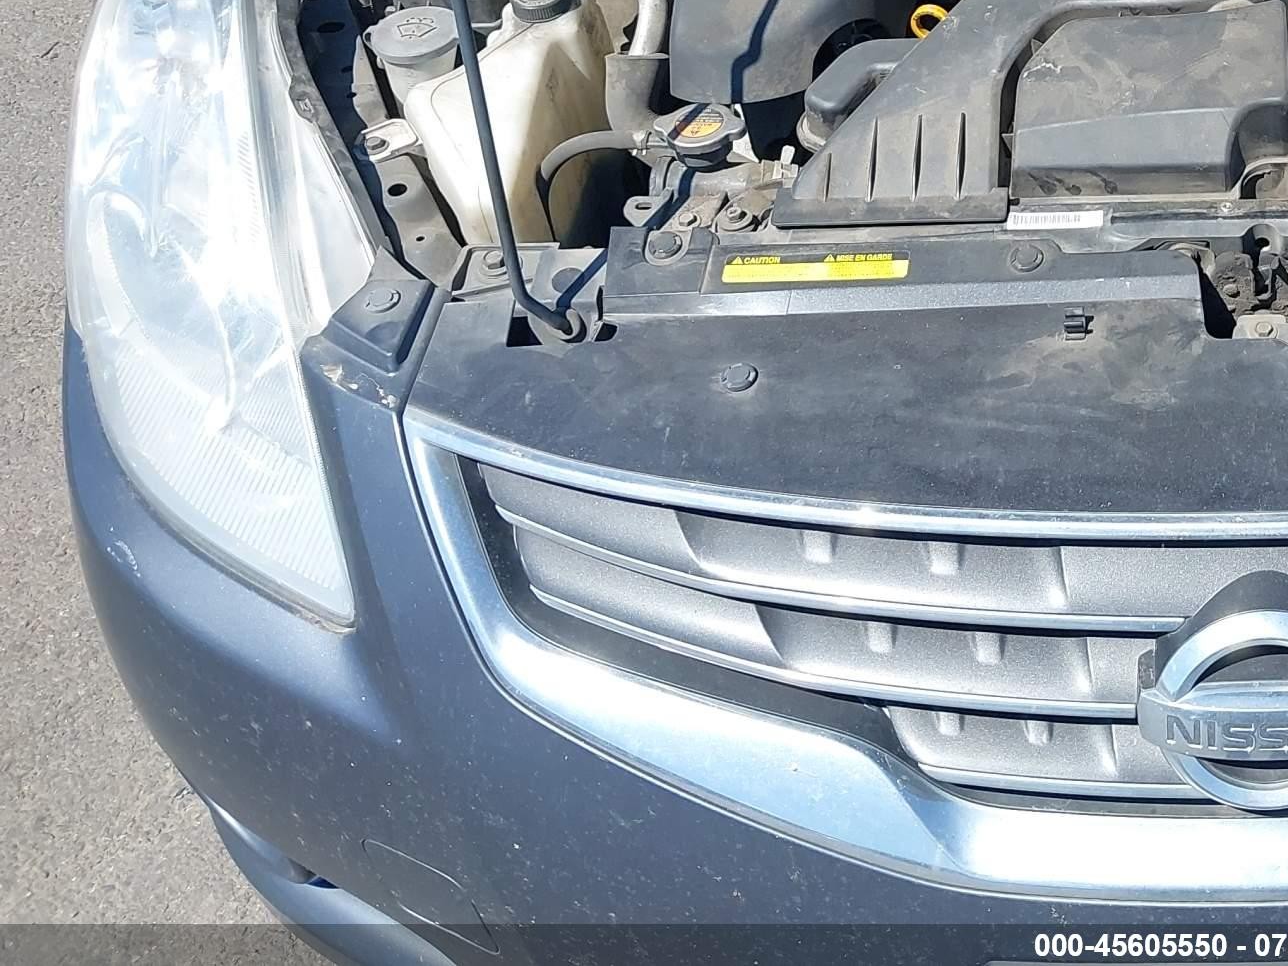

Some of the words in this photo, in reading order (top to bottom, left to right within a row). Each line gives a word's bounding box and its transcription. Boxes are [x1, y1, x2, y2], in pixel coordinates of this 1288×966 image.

[744, 256, 780, 264] CAUTION
[836, 254, 855, 262] MISE
[867, 253, 893, 261] GARDE
